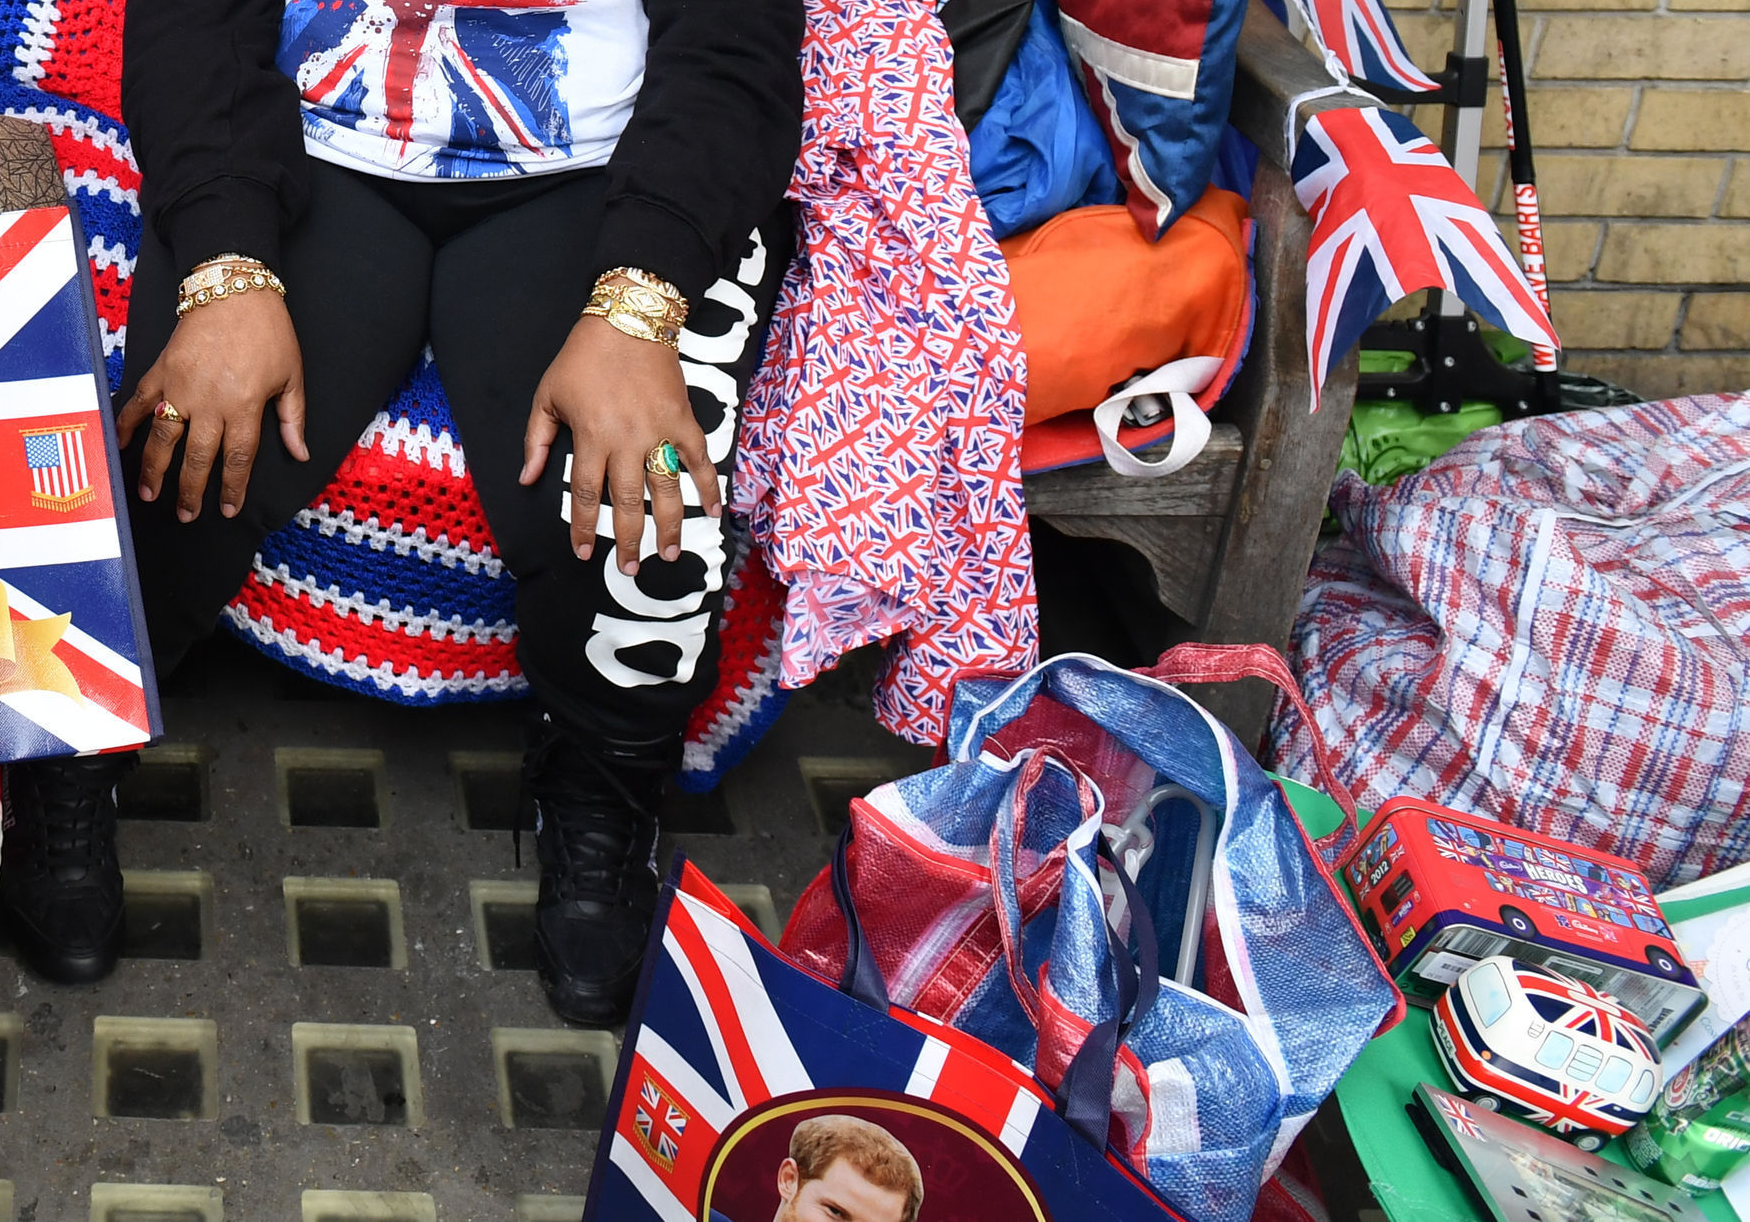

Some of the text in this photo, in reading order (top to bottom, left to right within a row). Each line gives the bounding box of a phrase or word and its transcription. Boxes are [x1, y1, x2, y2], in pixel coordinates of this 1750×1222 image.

[1514, 183, 1544, 256] BARTS
[1370, 860, 1390, 886] 2012
[1522, 861, 1589, 895] HEROES
